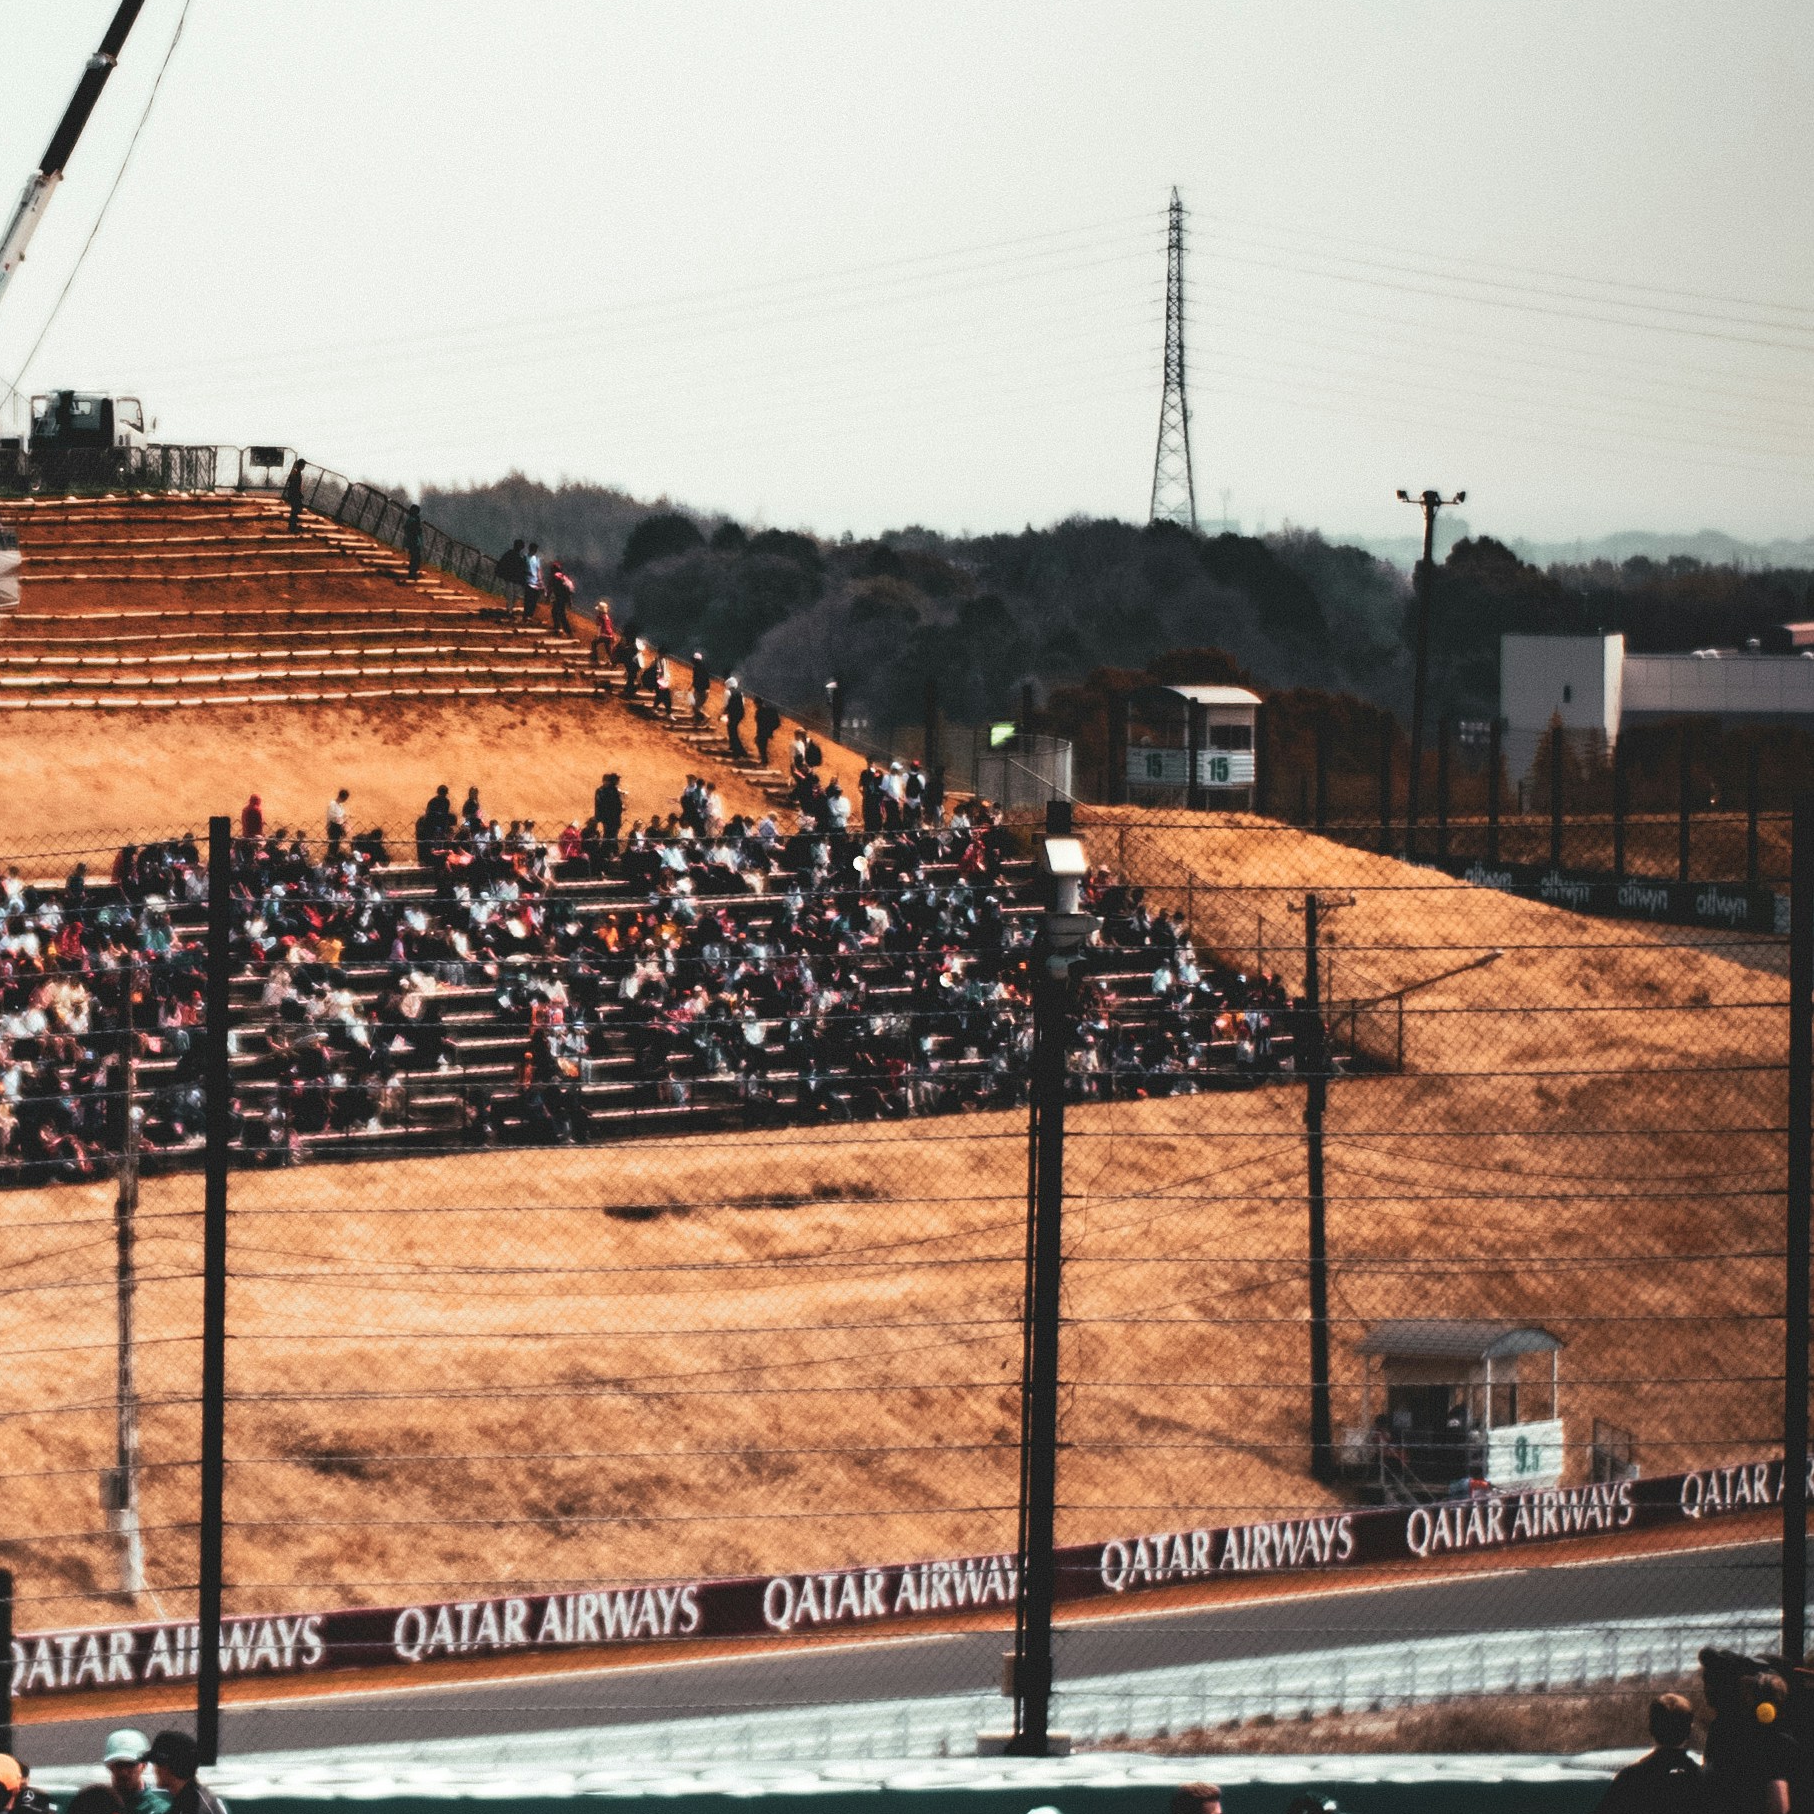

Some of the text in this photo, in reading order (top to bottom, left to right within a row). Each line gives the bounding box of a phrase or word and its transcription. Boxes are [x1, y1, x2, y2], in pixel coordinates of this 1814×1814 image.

[1145, 753, 1163, 778] 15
[1208, 757, 1229, 782] 15
[1618, 879, 1669, 915] allwyn
[1696, 887, 1748, 924] allwyn
[1679, 1463, 1770, 1518] QATAR
[1406, 1482, 1633, 1557] QATAR AIRWAYS
[1101, 1515, 1354, 1591] QATAR AIRWAYS
[763, 1554, 1020, 1630] QATAR AIRWAY
[393, 1586, 699, 1662] QATAR AIRWAYS
